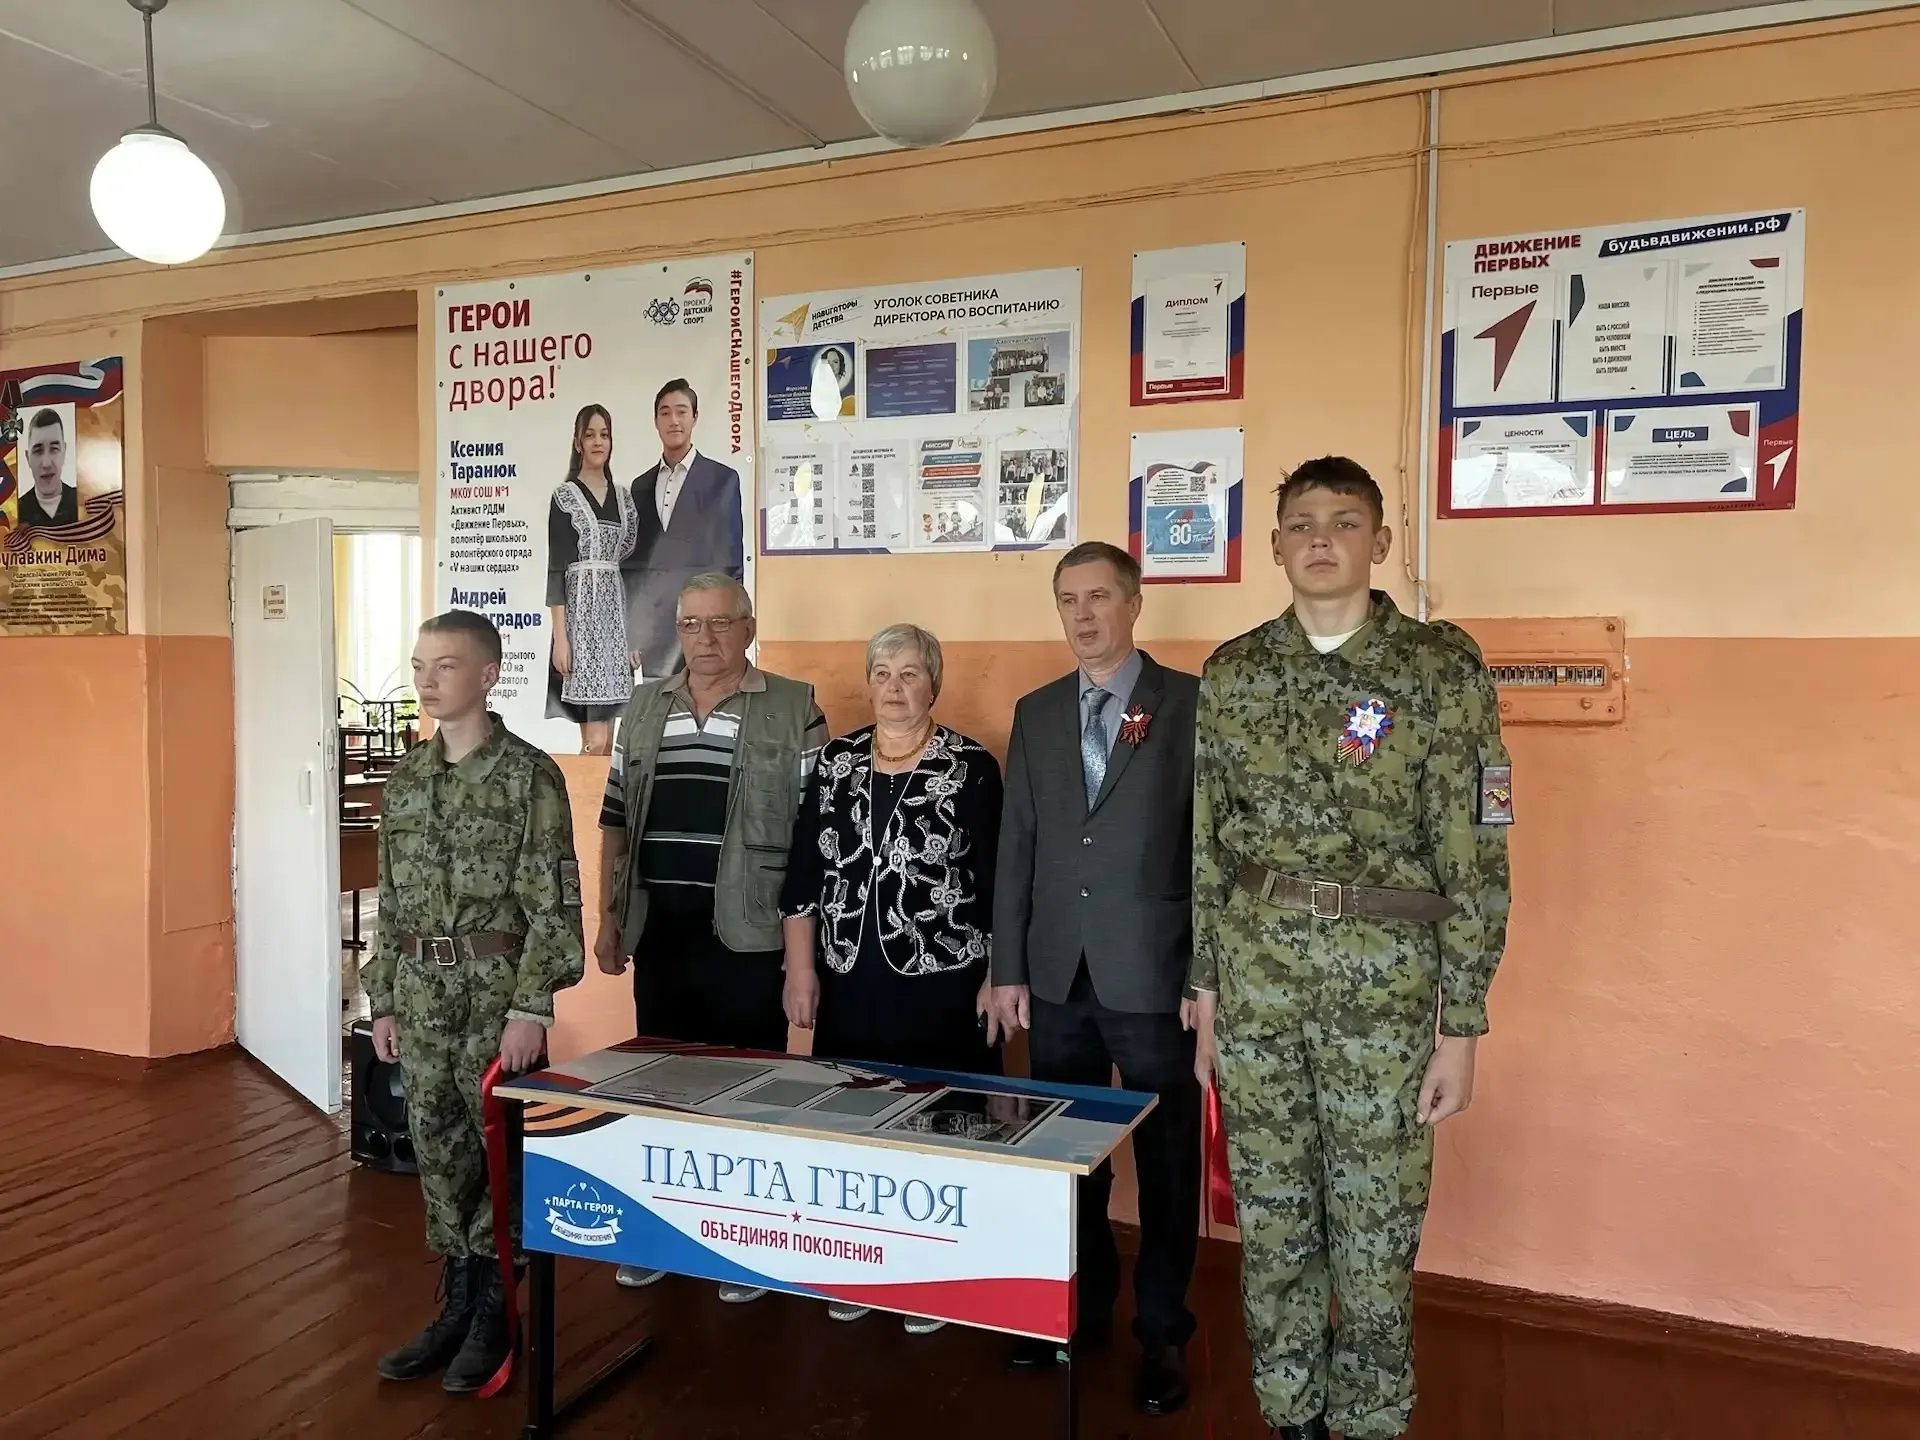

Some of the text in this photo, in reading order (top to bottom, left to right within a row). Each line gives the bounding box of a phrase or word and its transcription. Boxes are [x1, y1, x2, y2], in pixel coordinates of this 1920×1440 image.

[1608, 216, 1782, 252] будьвдвижении.рф
[1474, 235, 1582, 260] ДВИЖЕНИЕ
[1474, 255, 1550, 274] ПЕРВЫХ
[873, 289, 999, 311] УГОЛОК СОВЕТНИКА
[1471, 284, 1540, 301] Первые
[683, 304, 713, 317] ДЕТСКИЙ
[684, 298, 706, 307] ПРОЕКТ
[811, 299, 858, 321] НАВИГАТОРЫ
[1164, 297, 1209, 310] ДИПЛОМ
[448, 299, 531, 333] ГЕРОИ
[683, 316, 705, 325] СПОРТ
[812, 313, 845, 332] ДЕТСТВА
[873, 298, 1061, 328] ДИРЕКТОРА ПО ВОСПИТАНИЮ
[449, 332, 593, 369] с нашего
[449, 365, 556, 412] двора!
[1504, 429, 1545, 438] ЦЕННОСТИ
[1665, 430, 1696, 441] ЦЕЛЬ
[1763, 439, 1794, 447] Первые
[450, 440, 504, 459] Ксения
[450, 462, 518, 484] Таранюк
[450, 488, 473, 499] МКОУ
[473, 486, 493, 498] СОШ
[450, 503, 505, 516] Активист РДДМ
[450, 519, 491, 532] «Движение
[1169, 523, 1192, 545] 80
[450, 533, 527, 546] волонтёр школьного
[65, 545, 107, 567] Дима
[450, 547, 533, 560] волонтёрского отряда
[460, 562, 485, 573] наших
[450, 587, 507, 609] Андрей
[641, 1144, 969, 1228] ПАРТА ГЕРОЯ
[552, 1196, 615, 1214] ПАРТА ГЕРОЯ
[554, 1224, 613, 1242] ОБЪЕДИНЯЯ ПОКОЛЕНИЯ
[700, 1219, 884, 1265] ОБЪЕДИНЯЯ ПОКОЛЕНИЯ
